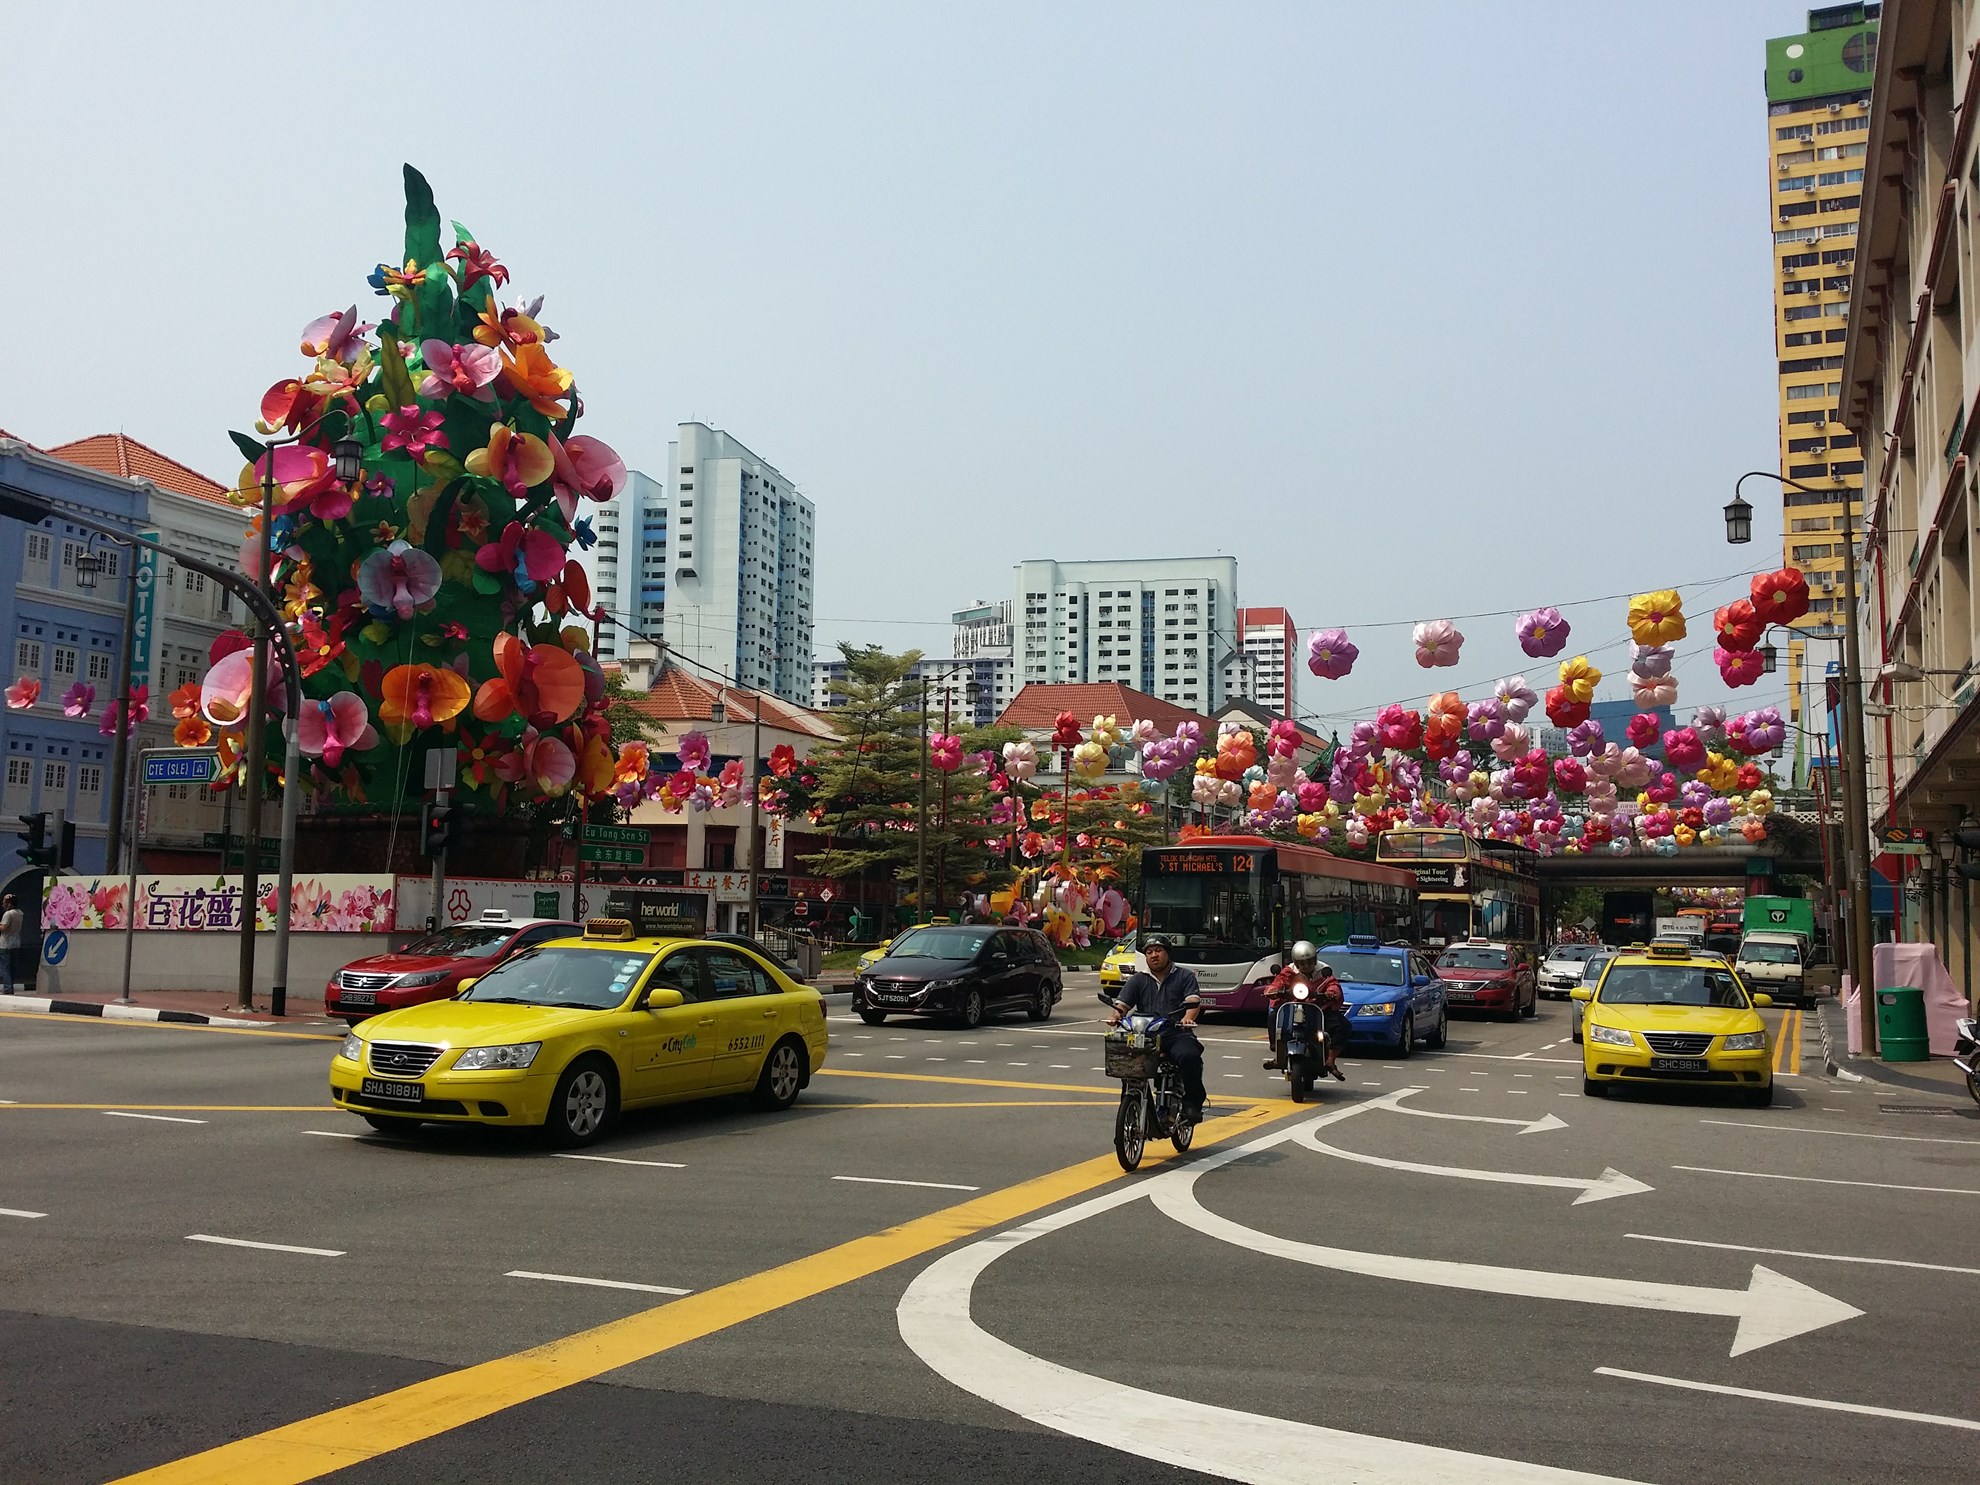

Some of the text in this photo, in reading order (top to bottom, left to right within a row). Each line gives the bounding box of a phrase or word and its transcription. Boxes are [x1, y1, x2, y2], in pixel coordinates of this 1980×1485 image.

[135, 546, 154, 663] HOTEL
[148, 762, 189, 776] CTE (SLE)
[585, 826, 596, 837] Eu
[600, 827, 618, 841] Tong
[621, 829, 636, 841] Sen
[638, 831, 648, 842] St
[595, 848, 632, 862] 余东旋街
[1169, 862, 1223, 872] ST MICHAEL'S
[1232, 855, 1255, 872] 124
[1420, 875, 1449, 883] Sightseeing
[1197, 970, 1218, 978] Transit
[728, 1034, 765, 1052] 6552 1111
